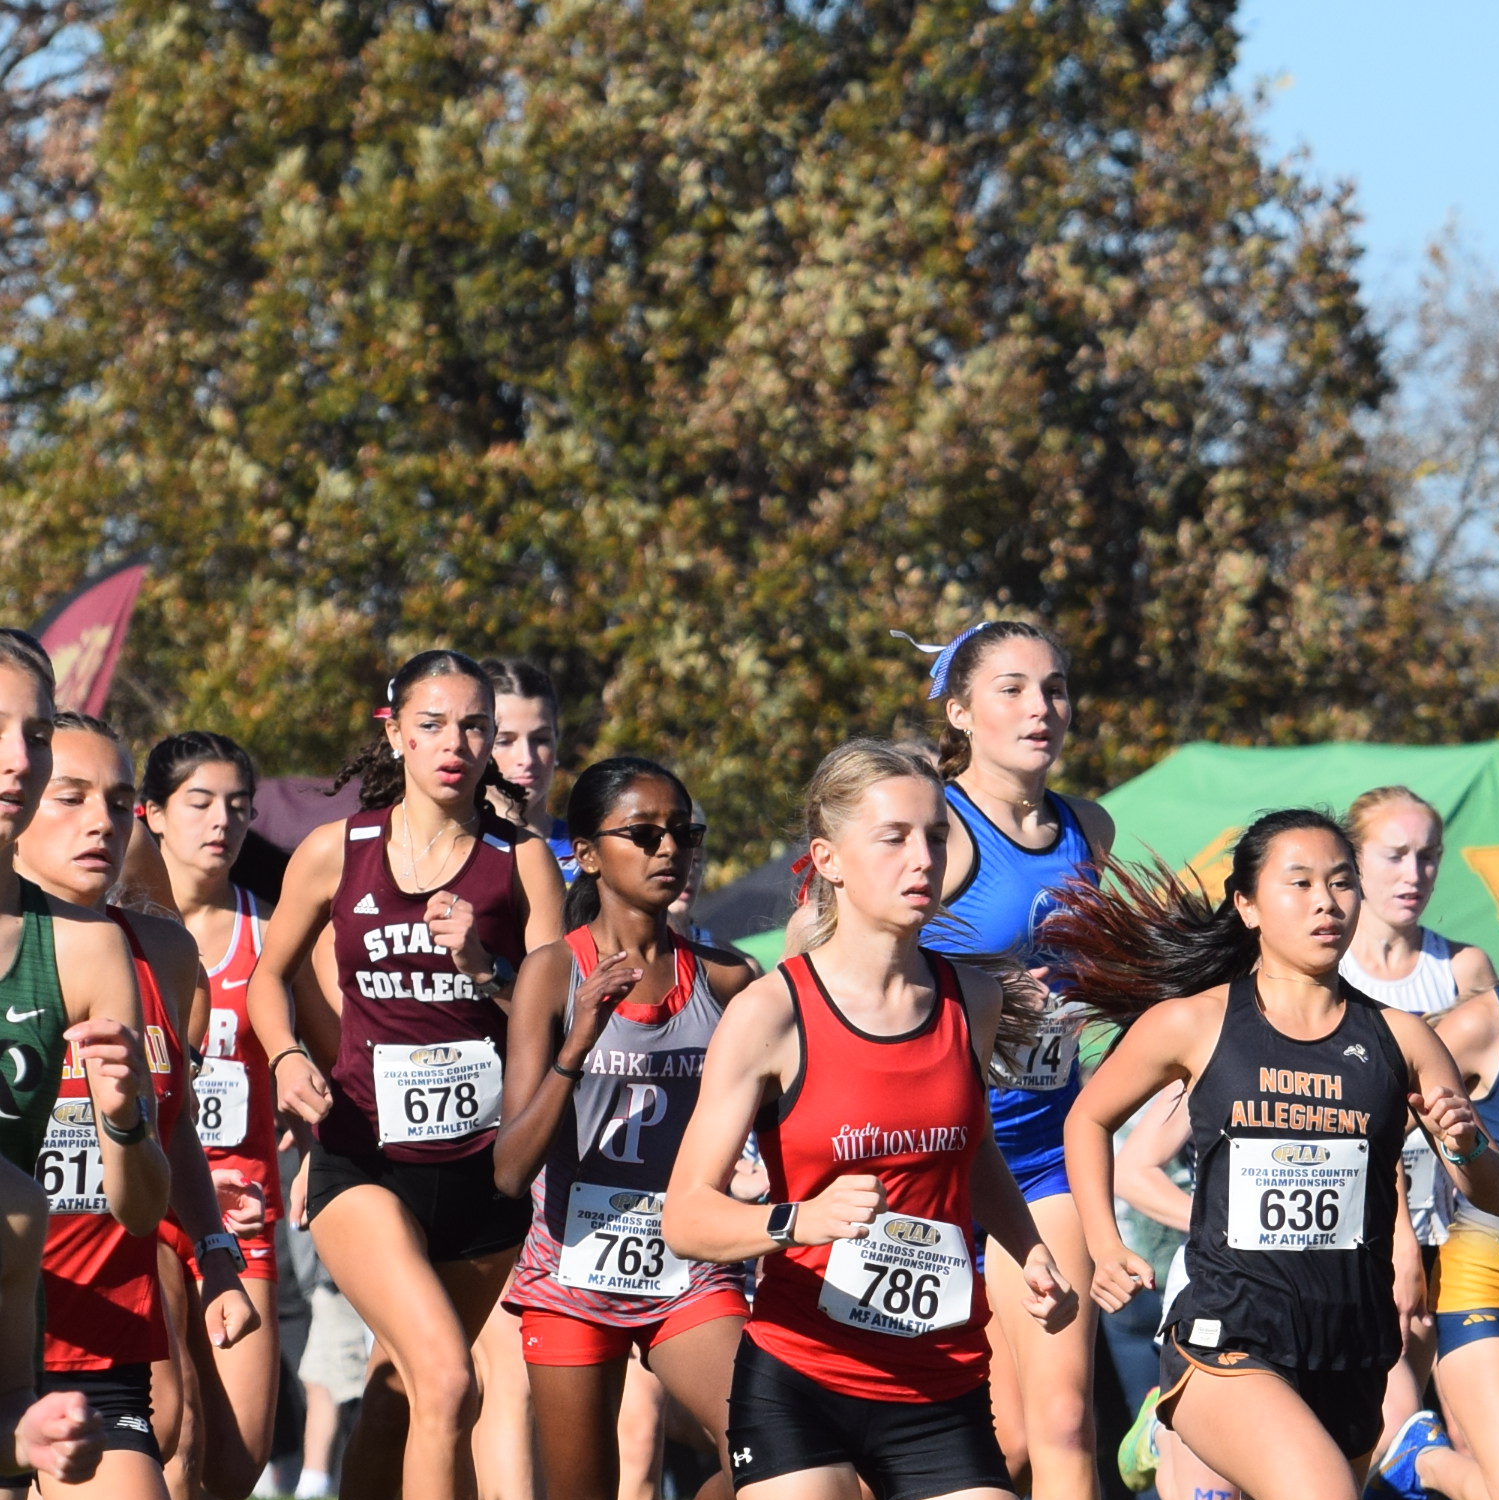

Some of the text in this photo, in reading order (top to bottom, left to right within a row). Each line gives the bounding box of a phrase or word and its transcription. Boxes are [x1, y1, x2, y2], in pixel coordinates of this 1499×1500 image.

[363, 923, 447, 962] STA
[356, 971, 479, 1002] COLLEG
[1026, 1035, 1061, 1074] 74
[383, 1061, 492, 1079] 2024 CROSS COUNTRY
[397, 1072, 480, 1087] CHAMPIONSHIPS
[1259, 1067, 1342, 1100] NORTH
[61, 1102, 95, 1124] PIA
[404, 1082, 479, 1125] 678
[426, 1118, 480, 1135] ATHLETIC
[1231, 1100, 1370, 1135] ALLEGHENY
[50, 1129, 91, 1138] CROSS
[201, 1132, 220, 1140] ETIC
[838, 1122, 881, 1139] Lady
[42, 1138, 100, 1148] HAMPION
[831, 1126, 968, 1162] MILLIONAIRES
[1280, 1145, 1328, 1164] PIAA
[1241, 1168, 1359, 1178] 2024 CROSS COUNTRY
[1255, 1177, 1345, 1187] CHAMPIONSHIPS
[57, 1198, 107, 1209] ATHLET
[1259, 1188, 1339, 1232] 636
[577, 1210, 604, 1221] 2024
[607, 1215, 643, 1225] CROSS
[892, 1221, 938, 1246] PIAA
[1280, 1233, 1336, 1245] ATHLETIC
[595, 1232, 665, 1278] 763
[847, 1238, 967, 1268] 2024 CROSS COUNTRY
[861, 1251, 950, 1275] CHAMPIONSHIPS
[607, 1276, 660, 1291] ATHLETIC
[858, 1262, 941, 1320] 786
[871, 1313, 935, 1333] ATHLETIC
